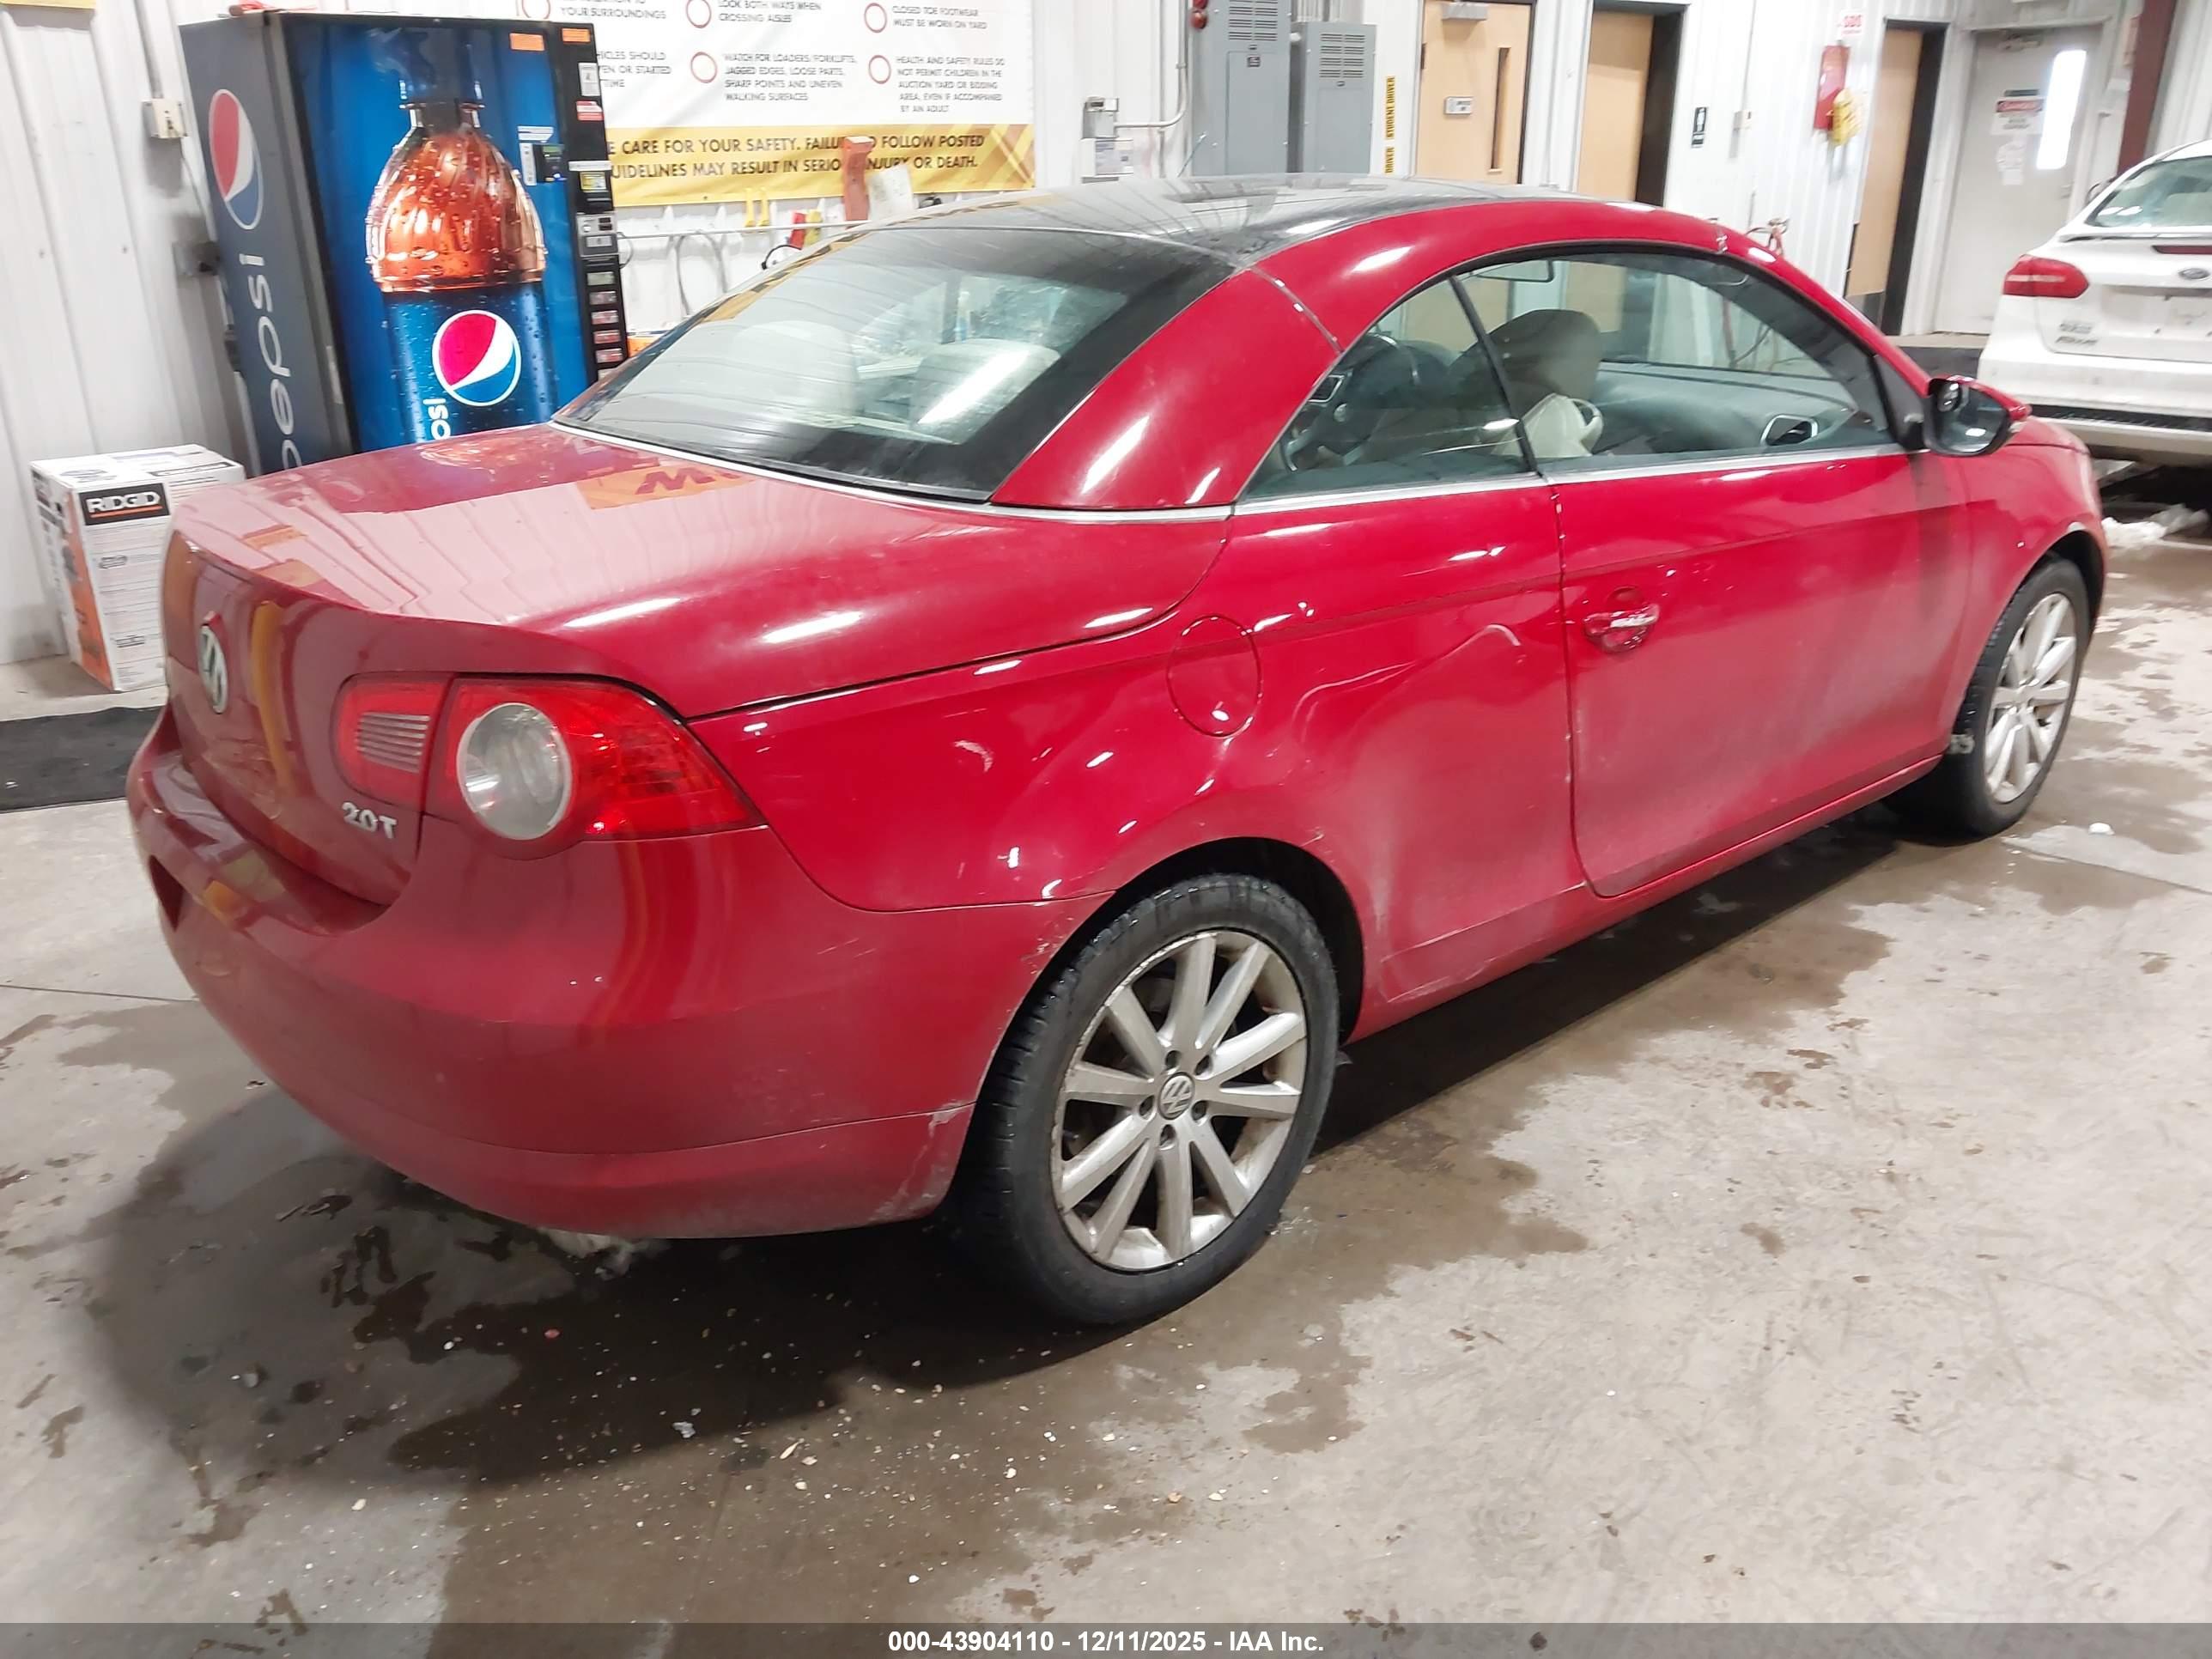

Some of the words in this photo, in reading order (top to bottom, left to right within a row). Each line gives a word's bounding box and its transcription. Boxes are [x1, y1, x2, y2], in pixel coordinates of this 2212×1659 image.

[744, 0, 769, 9] BOTH
[797, 2, 822, 10] WHEN
[561, 7, 588, 17] YOUR
[591, 8, 667, 19] SURROUNDINGS
[892, 6, 921, 15] CLOSED
[939, 7, 979, 16] FOOTWEAR
[719, 13, 764, 21] CROSSING
[893, 19, 915, 27] MUST
[916, 19, 927, 27] BE
[928, 20, 952, 28] WORN
[597, 51, 627, 60] HICLES
[629, 52, 667, 61] SHOULD
[725, 53, 753, 62] WATCH
[896, 56, 924, 64] HEALTH
[945, 57, 971, 65] SAFETY
[973, 58, 994, 66] RULES
[618, 65, 633, 74] OR
[635, 65, 672, 75] STARTED
[725, 67, 757, 76] JAGGED
[789, 67, 817, 76] LOOSE
[945, 69, 979, 77] CHILDREN
[725, 79, 751, 88] SHARP
[755, 80, 786, 88] POINTS
[788, 80, 806, 88] AND
[809, 80, 843, 88] UNEVEN
[898, 81, 933, 89] AUCTION
[934, 81, 955, 89] YARD
[957, 81, 968, 89] OR
[969, 82, 998, 90] BIDDING
[1386, 76, 1395, 104] DRIVER
[726, 93, 766, 101] WALKING
[923, 93, 943, 101] EVEN
[900, 105, 910, 113] BY
[1385, 106, 1395, 138] STUDENT
[621, 140, 659, 155] CARE
[664, 138, 695, 154] FOR
[698, 137, 742, 153] YOUR
[746, 137, 800, 152] SAFETY.
[805, 137, 842, 150] FAILU
[881, 135, 938, 149] FOLLOW
[939, 134, 985, 148] POSTED
[1384, 146, 1395, 173] DRIVER
[611, 162, 687, 179] UIDELINES
[692, 161, 726, 177] MAY
[731, 160, 780, 175] RESULT
[783, 160, 799, 173] IN
[803, 157, 841, 173] SERIO
[865, 156, 910, 171] NJURY
[913, 156, 933, 169] OR
[937, 155, 977, 169] DEATH.
[87, 490, 161, 514] RIDGID
